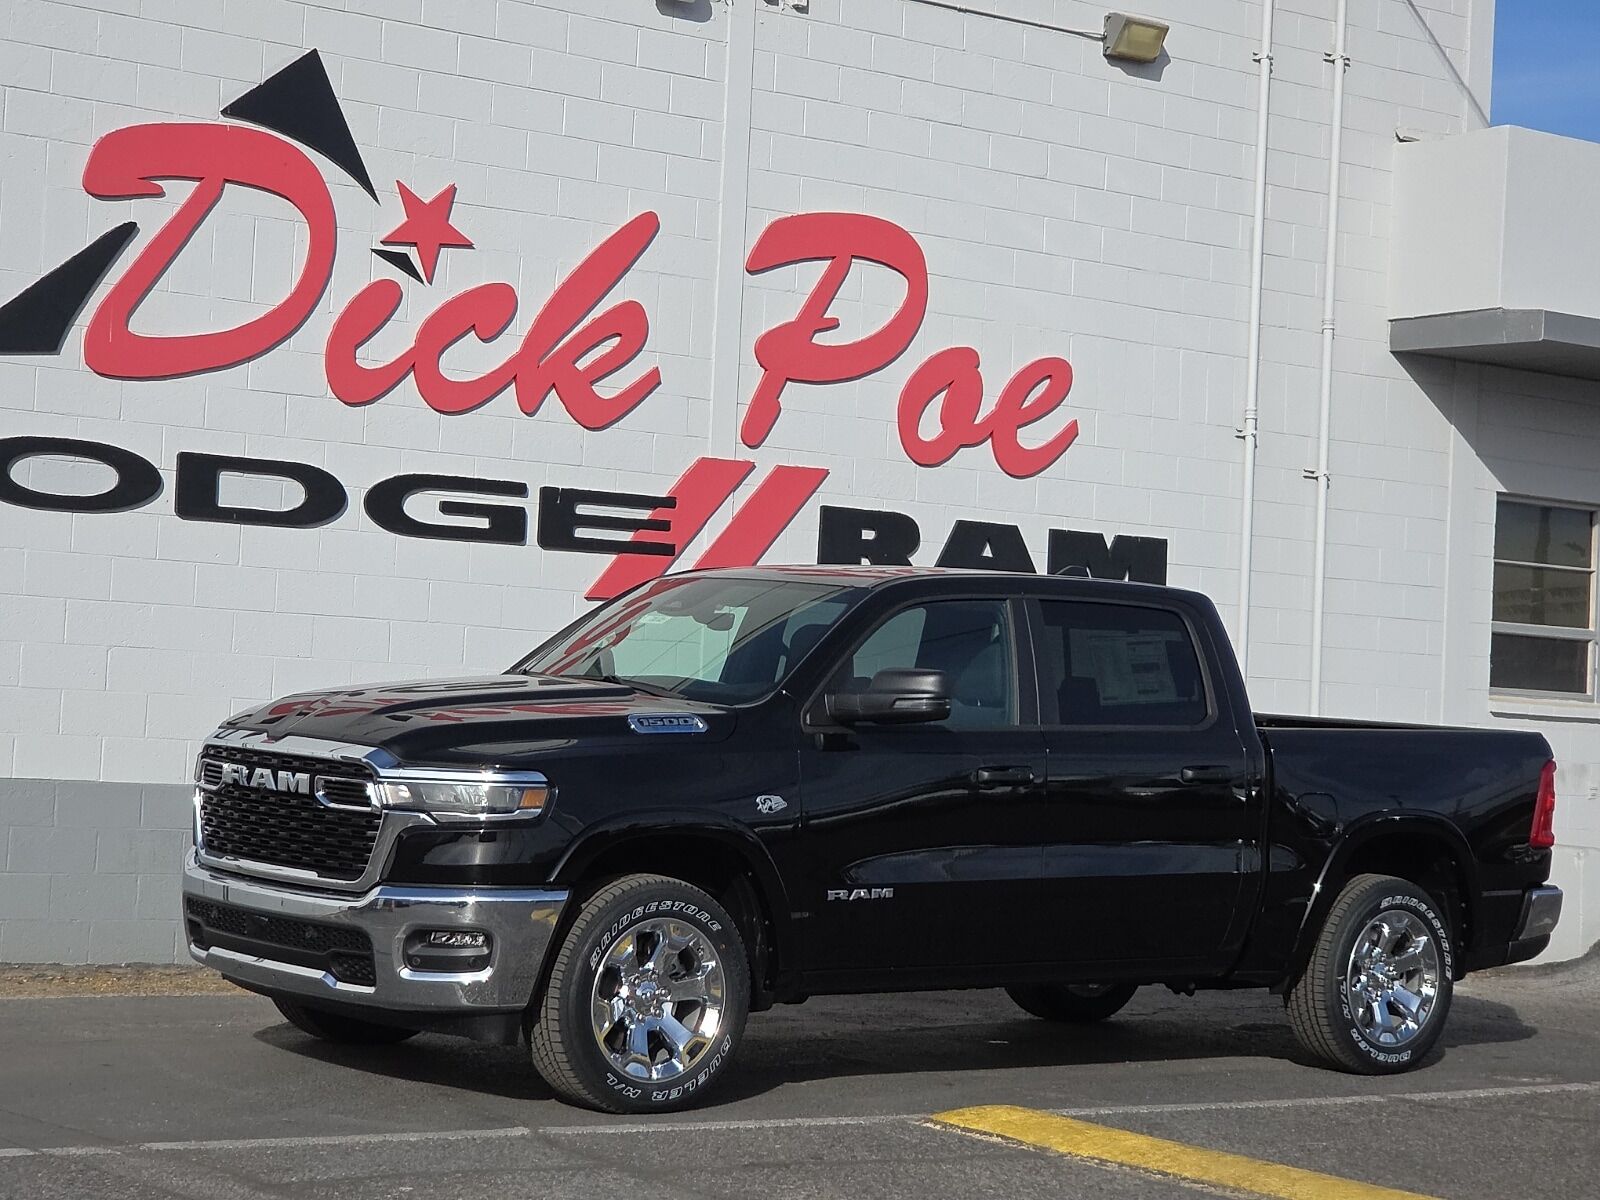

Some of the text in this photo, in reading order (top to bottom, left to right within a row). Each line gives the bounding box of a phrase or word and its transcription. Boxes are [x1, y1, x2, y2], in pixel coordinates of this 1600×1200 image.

[83, 122, 1079, 479] Dick Poe
[818, 505, 1168, 586] RAM
[639, 716, 696, 727] 1500
[222, 763, 310, 795] RAM
[827, 887, 894, 901] RAM
[589, 900, 722, 971] BRIDGESTONE
[1379, 895, 1453, 980] BRIDGESTONE
[606, 1033, 731, 1101] DUELER H/L
